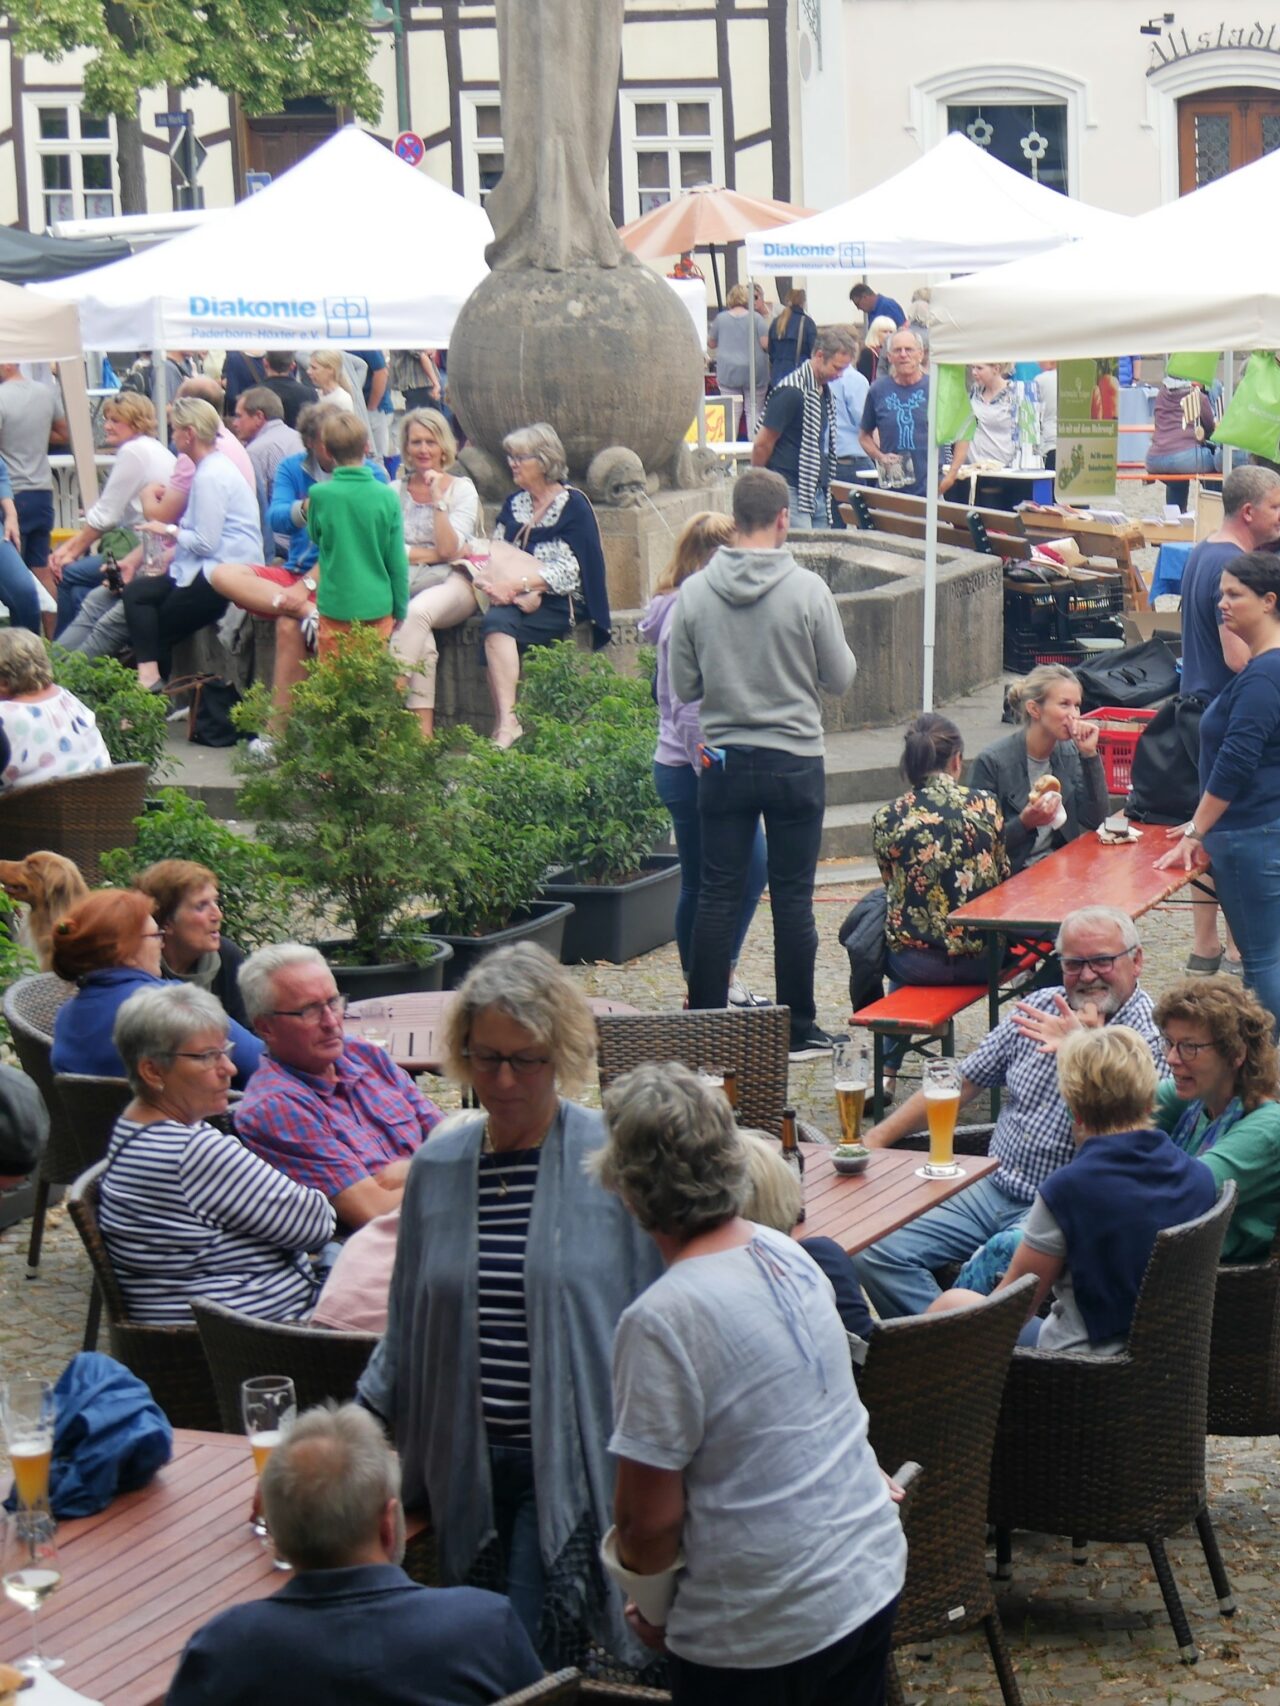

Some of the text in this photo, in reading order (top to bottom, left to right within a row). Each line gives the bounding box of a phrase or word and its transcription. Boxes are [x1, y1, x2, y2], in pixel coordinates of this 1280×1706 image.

[763, 243, 836, 257] Diakonie
[189, 296, 316, 317] Diakonie
[191, 327, 296, 339] Paderborn-Höxter
